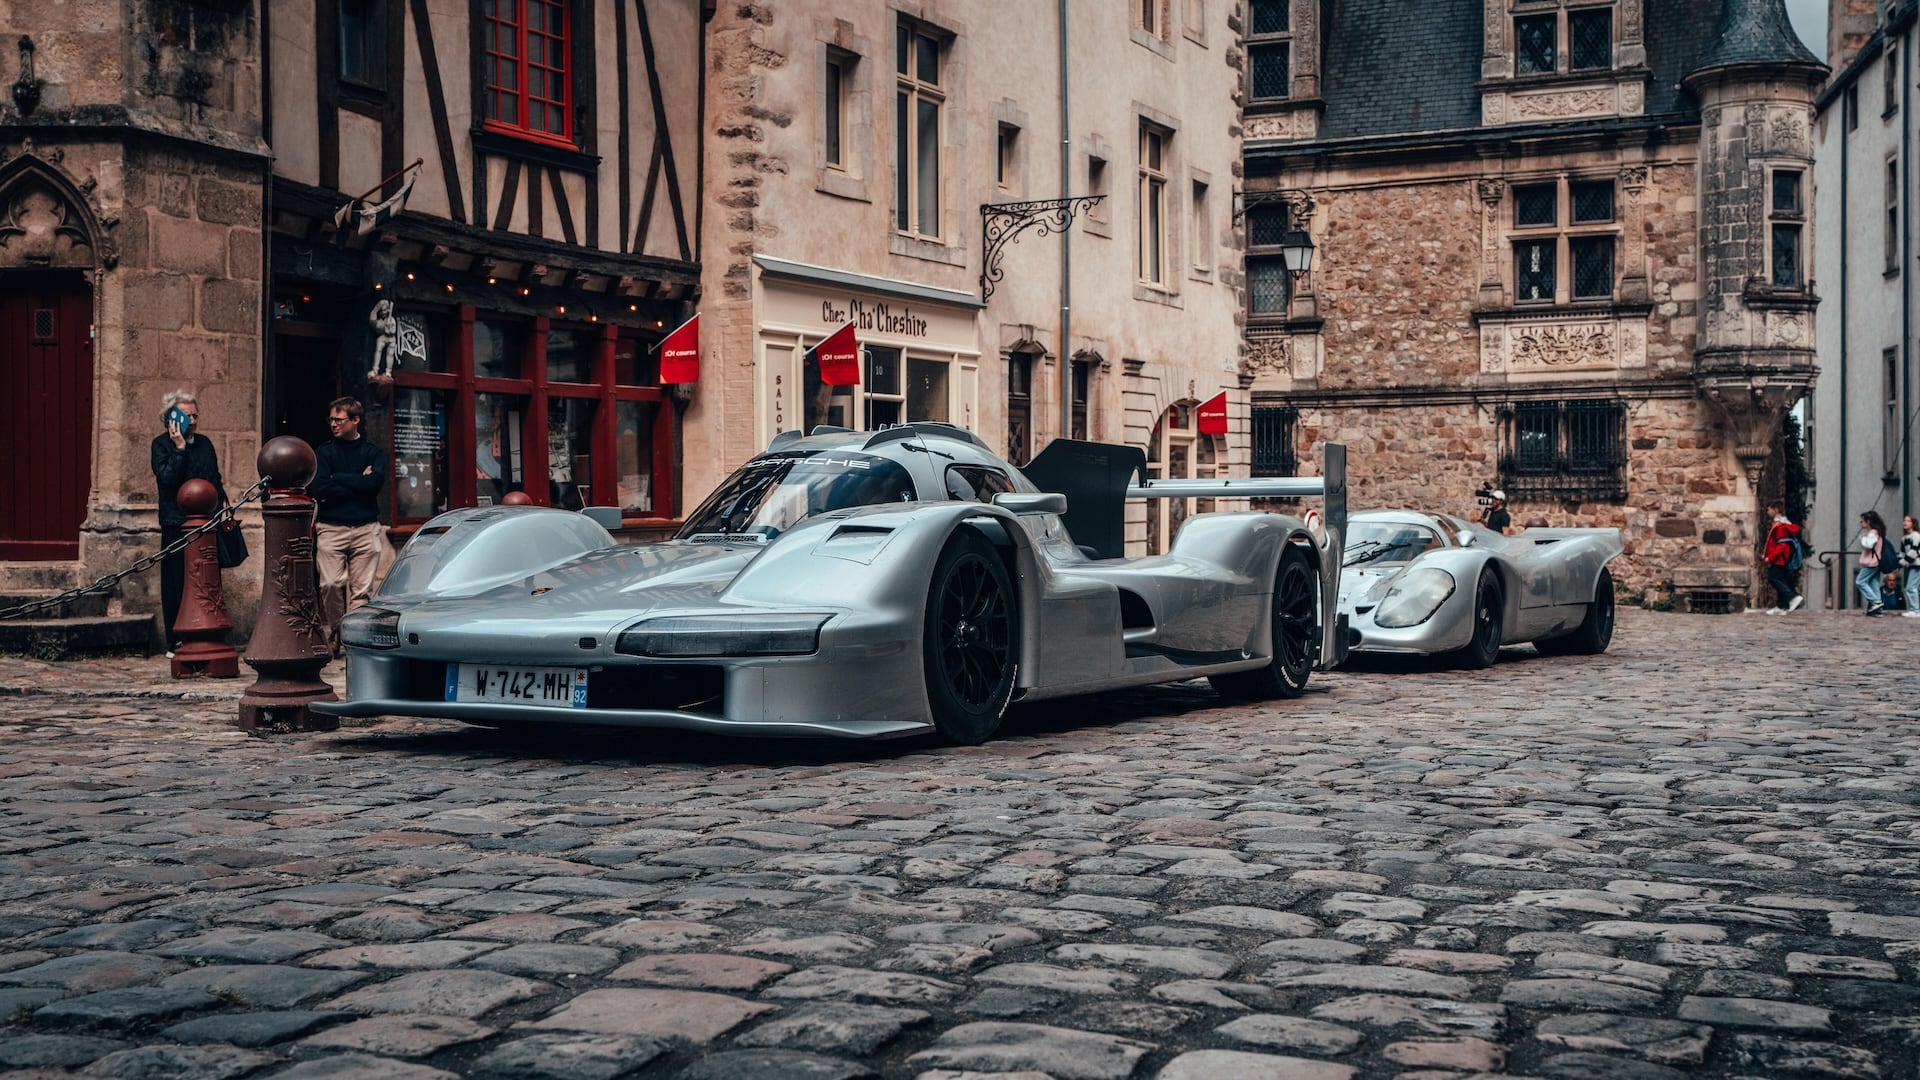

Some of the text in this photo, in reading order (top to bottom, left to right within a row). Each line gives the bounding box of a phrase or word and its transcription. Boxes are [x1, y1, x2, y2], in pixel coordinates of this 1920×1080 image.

[822, 300, 845, 324] Chez
[875, 366, 883, 375] 10
[448, 685, 454, 694] F
[574, 689, 586, 704] 92
